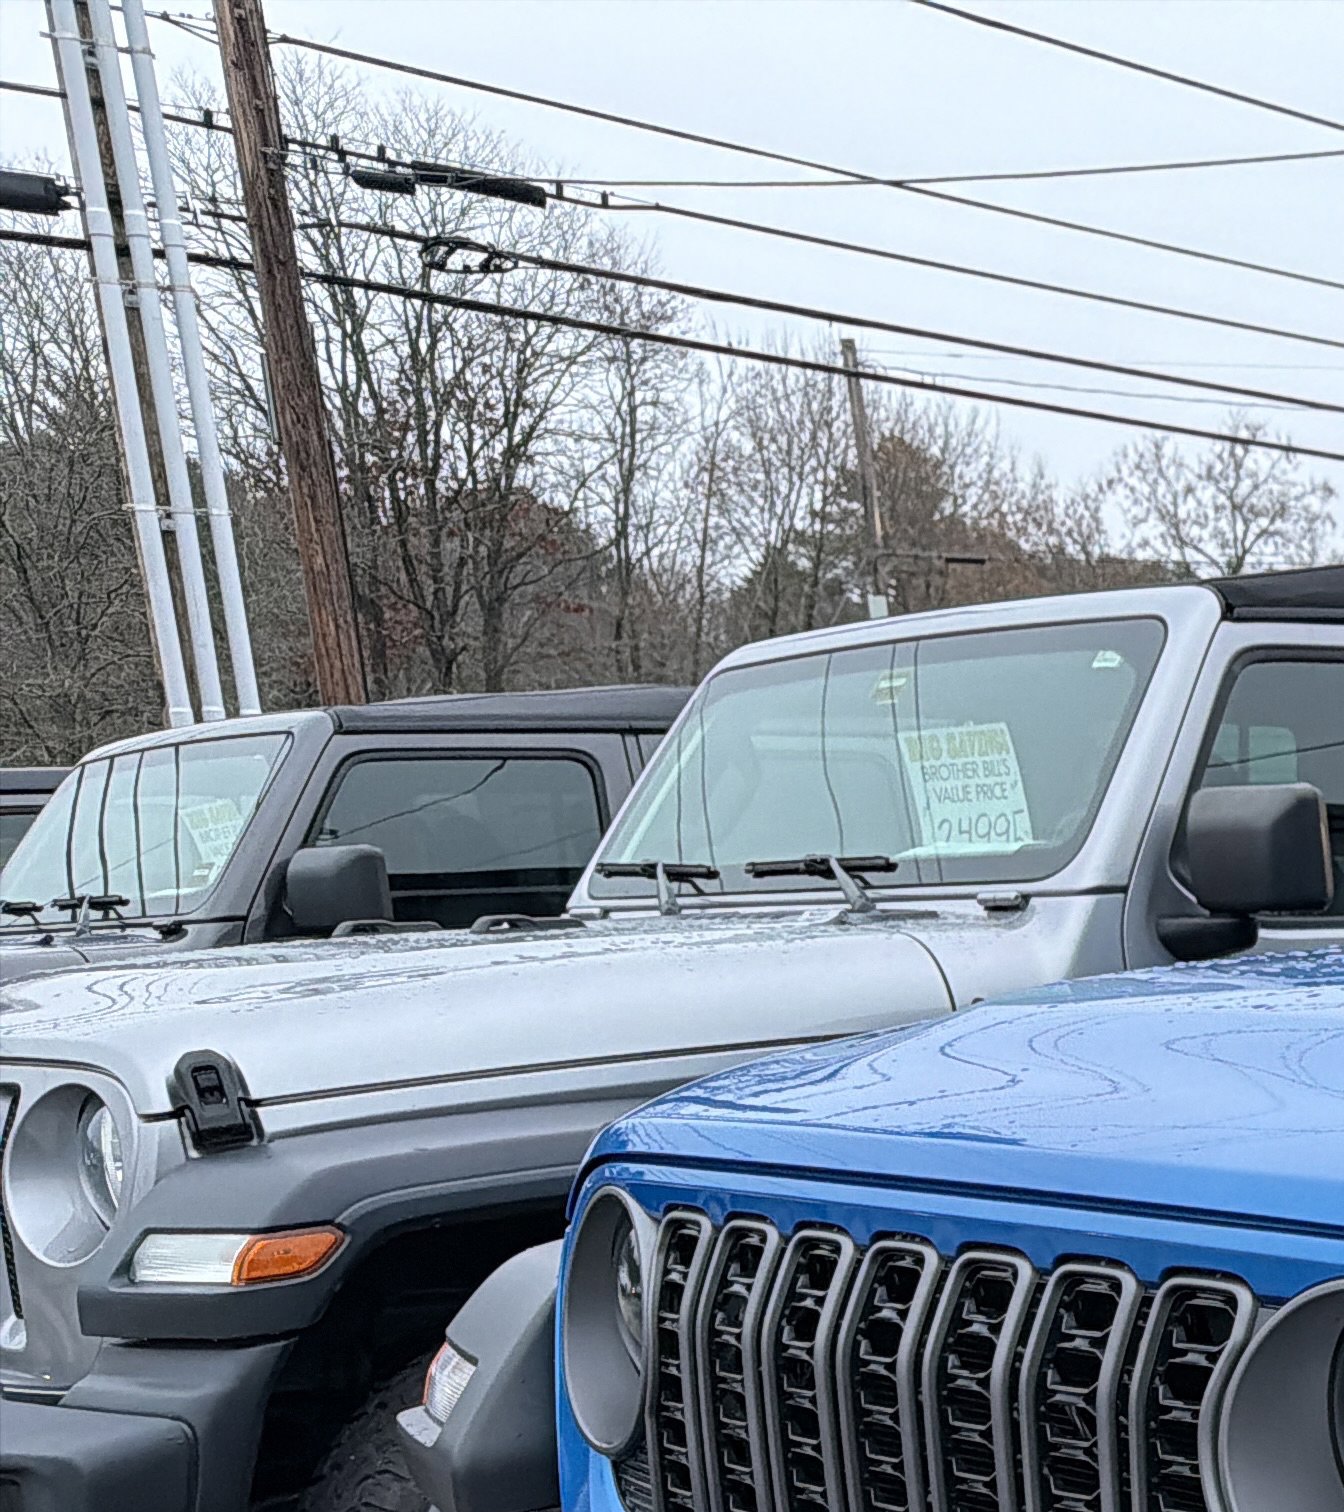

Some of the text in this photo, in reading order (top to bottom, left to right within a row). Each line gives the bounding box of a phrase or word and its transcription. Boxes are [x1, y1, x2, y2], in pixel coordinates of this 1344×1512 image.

[922, 759, 1011, 783] BROTHER BILL'S
[933, 783, 1009, 804] VALUE PRICE
